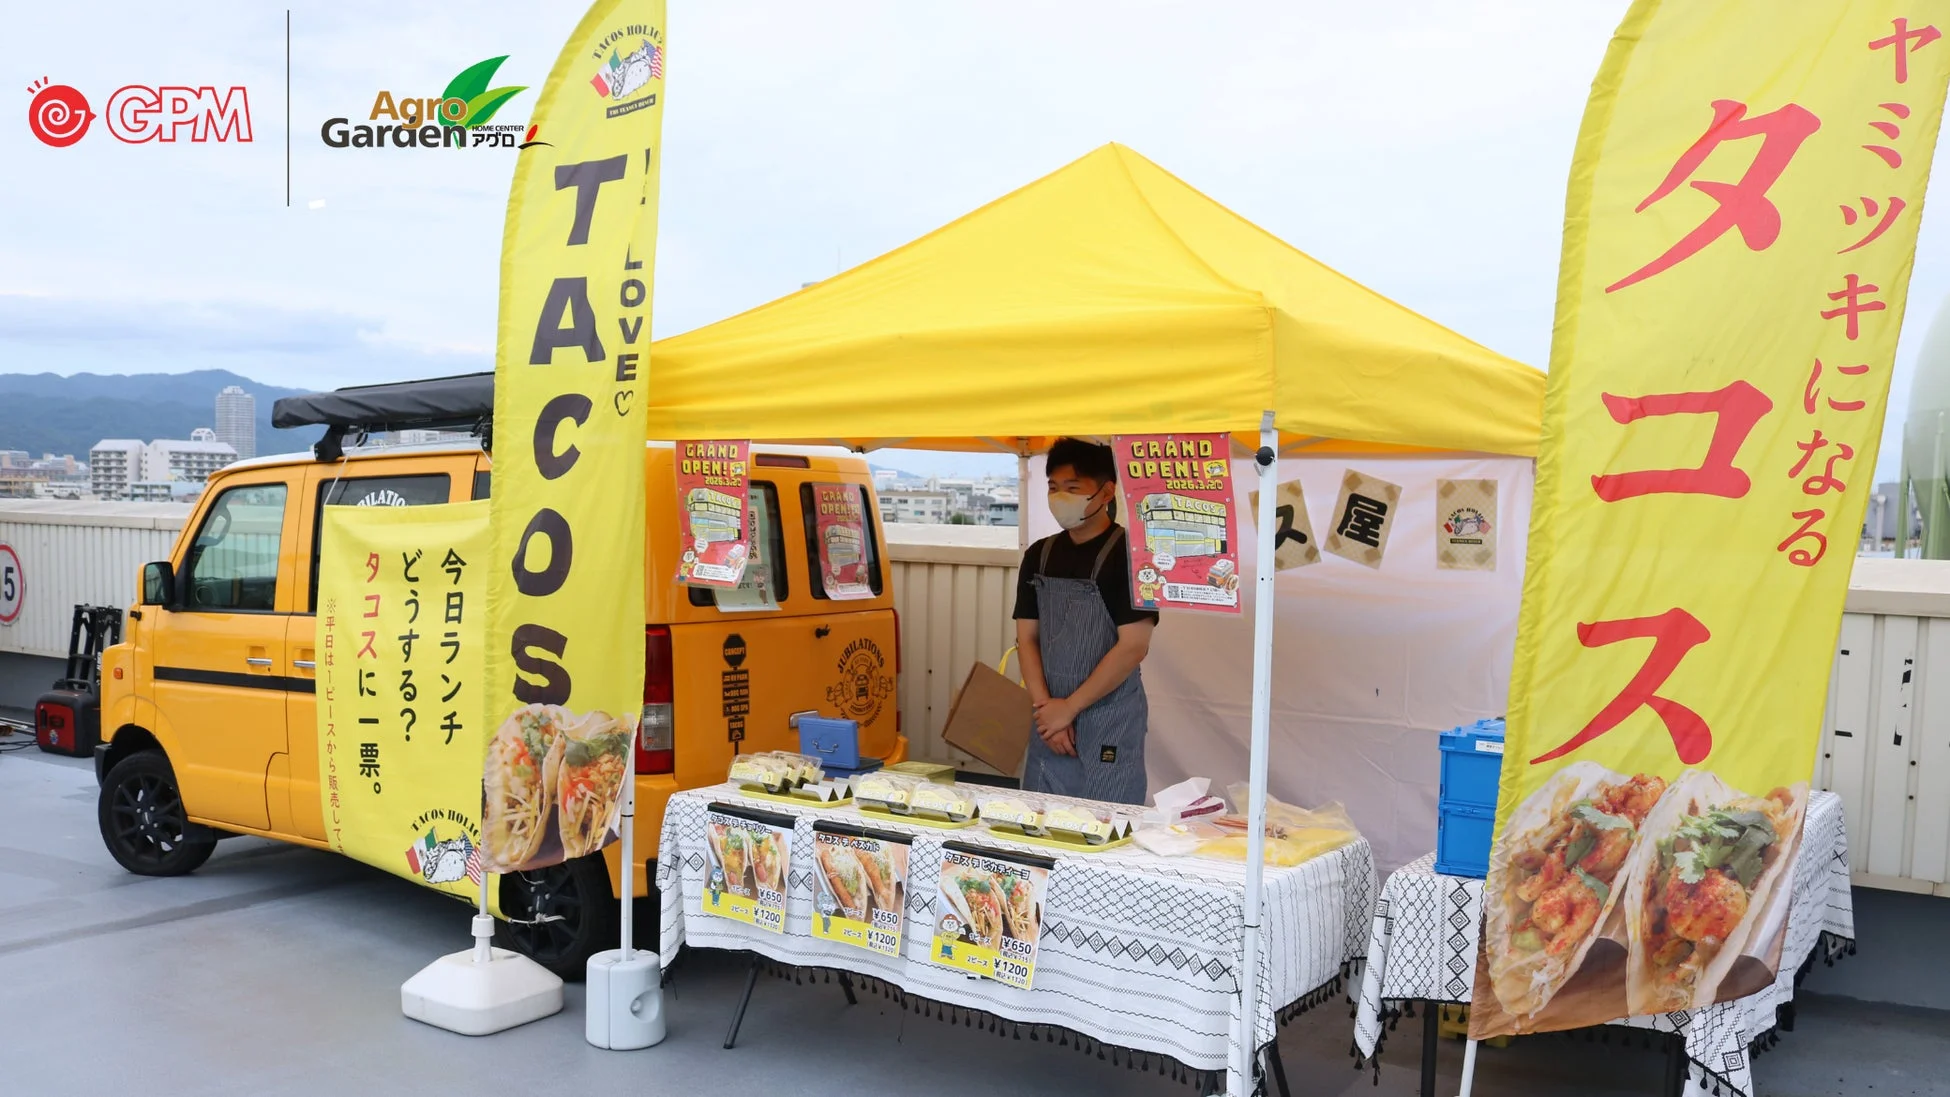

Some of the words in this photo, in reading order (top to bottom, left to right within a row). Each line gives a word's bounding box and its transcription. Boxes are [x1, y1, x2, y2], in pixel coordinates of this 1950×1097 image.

[592, 28, 624, 60] TACOS
[1776, 17, 1942, 567] ヤミツキになる
[511, 153, 628, 707] TACOS
[1529, 99, 1822, 765] タコス
[685, 443, 738, 459] GRAND
[1132, 440, 1212, 458] GRAND
[681, 459, 728, 476] OPEN!
[1128, 460, 1200, 478] OPEN!
[1174, 496, 1216, 513] TACOS
[0, 566, 15, 601] 5
[398, 548, 423, 742] どうする?
[440, 548, 467, 745] 今日ランチ
[838, 638, 885, 674] JUBILATIONS
[357, 552, 382, 794] タコスに一票。
[411, 808, 444, 832] TACOS
[818, 833, 840, 846] タコス
[944, 851, 971, 867] タコス
[760, 889, 782, 903] ¥650
[754, 907, 781, 923] ¥1200
[874, 909, 898, 924] ¥650
[867, 929, 896, 946] ¥1200
[1003, 937, 1032, 954] ¥650
[994, 958, 1028, 978] ¥1200
